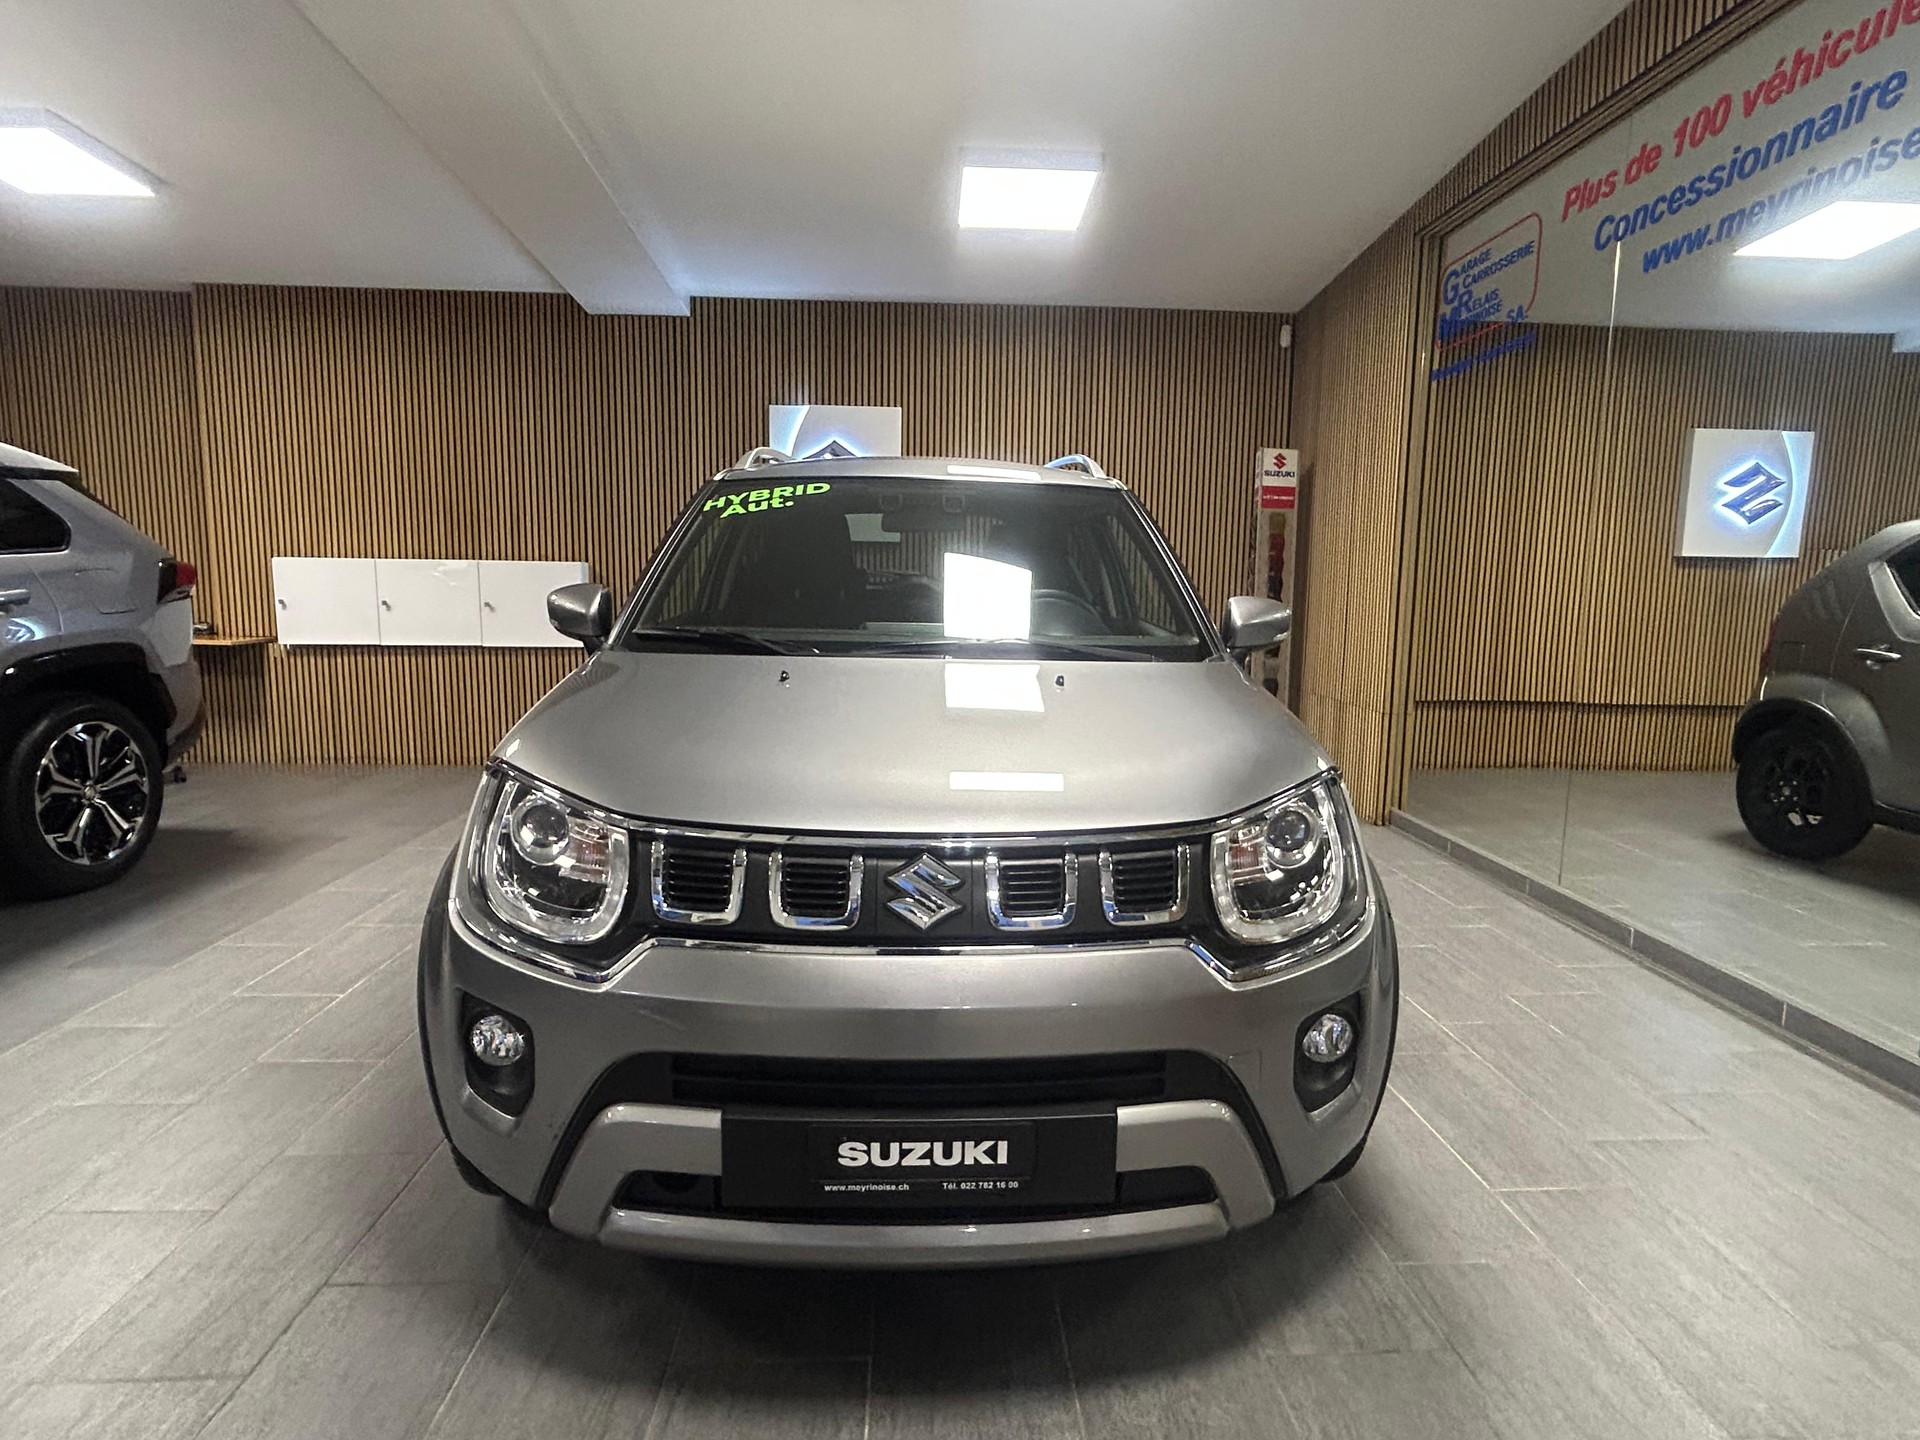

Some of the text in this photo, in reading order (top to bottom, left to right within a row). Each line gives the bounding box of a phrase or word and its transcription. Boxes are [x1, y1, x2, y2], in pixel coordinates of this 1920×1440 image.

[1561, 0, 1920, 223] Plus de 100 véhicule
[1594, 70, 1907, 251] Concessionnaire
[1462, 240, 1535, 289] CARROSSERIE
[1264, 470, 1295, 478] SUZUKI
[703, 482, 831, 511] HYBRID
[720, 498, 794, 518] Aut.
[837, 1140, 1008, 1167] SUZUKI
[824, 1183, 910, 1193] www.meyrinoise.ch
[960, 1181, 976, 1190] 022
[978, 1181, 994, 1189] 782
[996, 1181, 1006, 1189] 16
